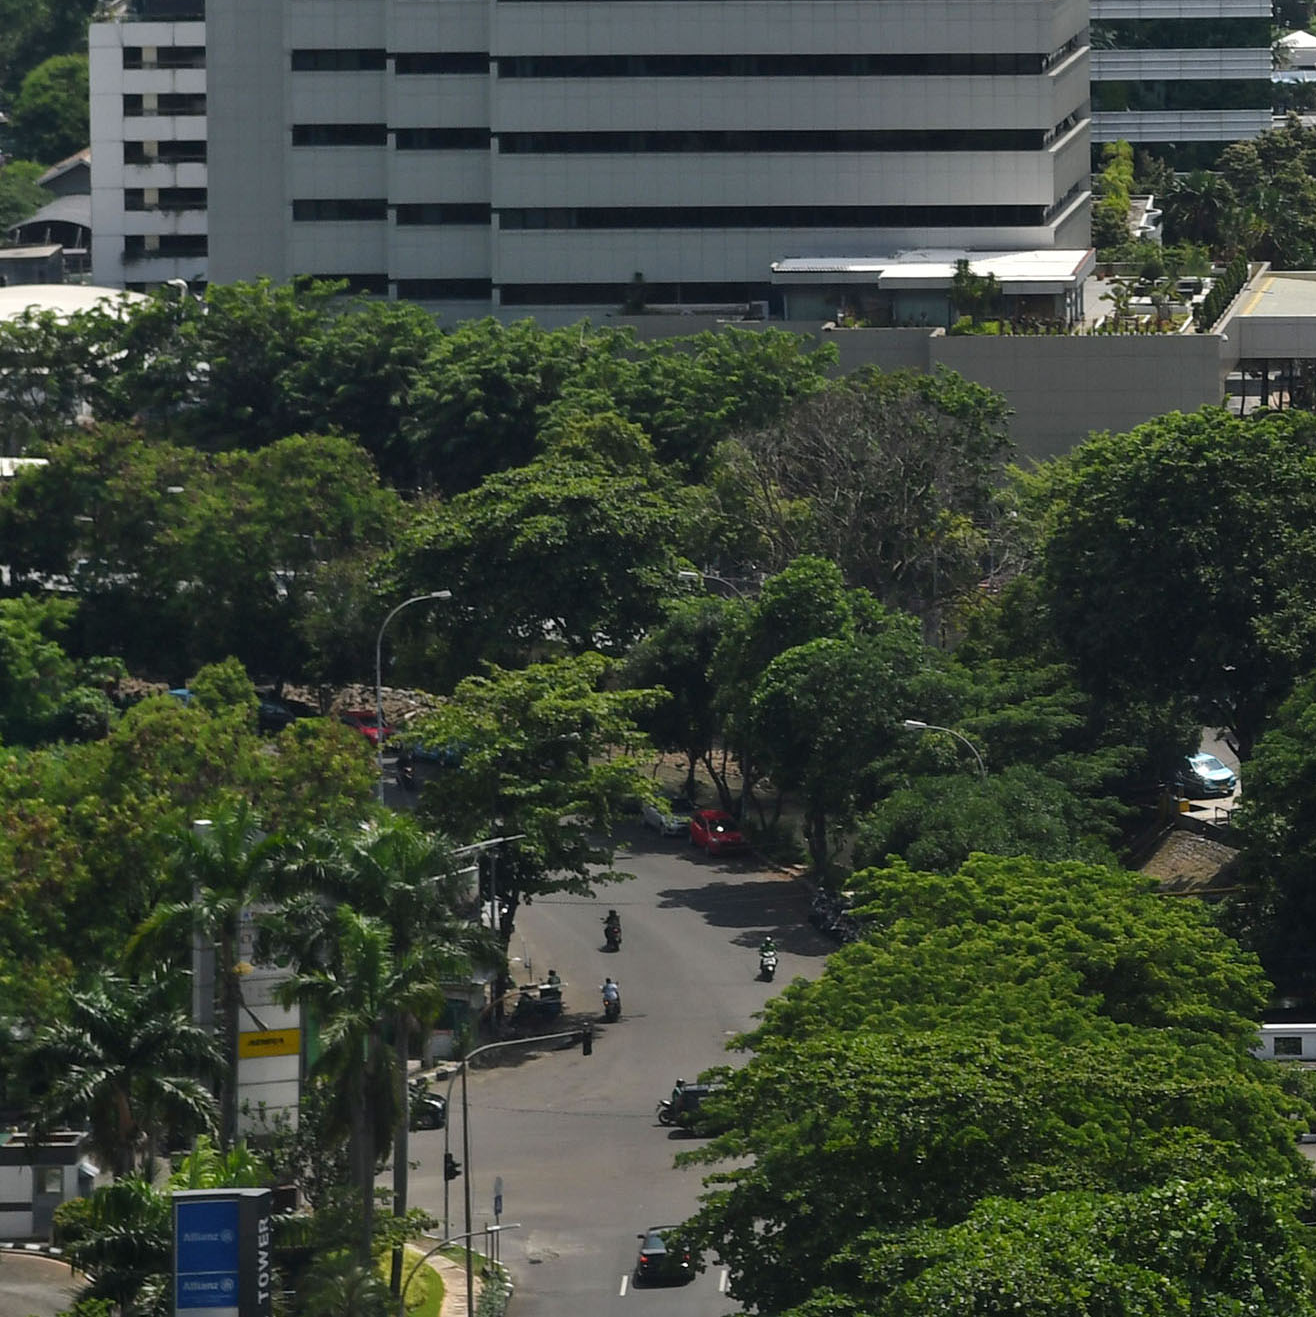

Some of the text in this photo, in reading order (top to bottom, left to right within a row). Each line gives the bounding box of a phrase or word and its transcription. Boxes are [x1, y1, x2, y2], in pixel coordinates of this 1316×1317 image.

[183, 1232, 219, 1242] Allianz
[257, 1216, 270, 1305] TOWER
[183, 1281, 219, 1291] Allianz
